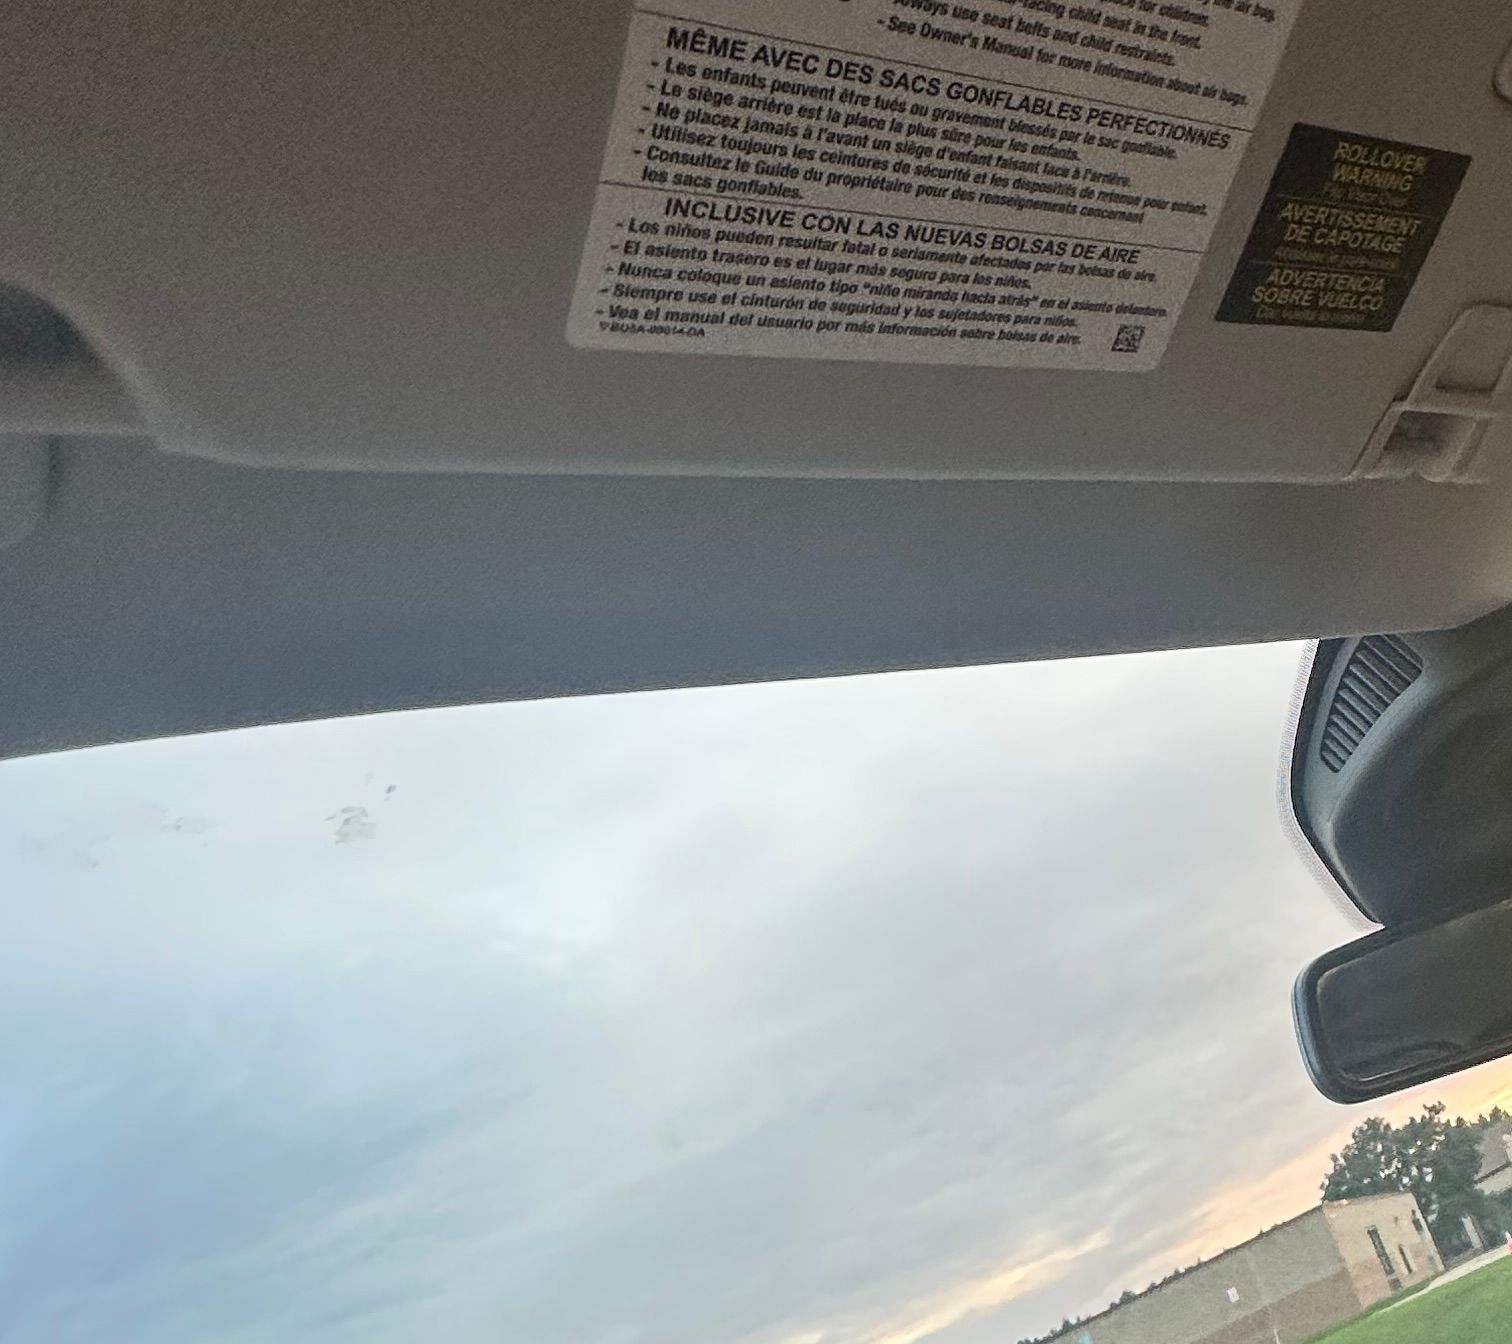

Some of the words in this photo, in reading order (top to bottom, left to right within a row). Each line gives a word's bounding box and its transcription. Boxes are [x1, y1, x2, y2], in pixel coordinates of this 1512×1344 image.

[886, 15, 916, 34] See
[951, 5, 978, 21] use
[664, 56, 696, 76] Les
[701, 67, 766, 88] enfants
[770, 79, 835, 100] peuvent
[666, 27, 746, 61] MÊME
[751, 45, 819, 74] AVEC
[825, 58, 873, 84] DES
[879, 69, 940, 96] SACS
[946, 82, 1081, 121] GONFLABLES
[1086, 108, 1230, 147] PERFECTIONNÉS
[683, 108, 740, 128] placez
[743, 116, 798, 137] jamais
[687, 86, 733, 106] siège
[737, 96, 793, 114] arrière
[797, 105, 823, 119] est
[843, 112, 885, 130] place
[720, 134, 787, 156] toujours
[792, 143, 815, 160] les
[819, 151, 888, 169] ceintures
[1334, 141, 1429, 174] ROLLOVER
[641, 166, 667, 183] les
[672, 173, 711, 188] sacs
[716, 179, 805, 198] gonflables.
[646, 146, 731, 169] Consultez
[754, 160, 799, 178] Guide
[826, 172, 911, 193] propriétaire
[1331, 162, 1414, 192] WARNING
[628, 218, 659, 234] Los
[664, 223, 710, 239] niños
[714, 230, 773, 245] pueden
[778, 236, 838, 250] resultar
[665, 198, 795, 227] INCLUSIVE
[801, 213, 851, 234] CON
[856, 219, 899, 239] LAS
[904, 225, 986, 248] NUEVAS
[991, 234, 1067, 256] BOLSAS
[1070, 242, 1097, 259] DE
[1097, 246, 1141, 264] AIRE
[1279, 202, 1423, 236] AVERTISSEMENT
[1284, 223, 1309, 243] DE
[1314, 226, 1408, 254] CAPOTAGE
[644, 244, 707, 260] asiento
[712, 249, 769, 266] trasero
[813, 258, 853, 274] lugar
[617, 263, 672, 279] Nunca
[677, 269, 741, 285] coloque
[769, 276, 825, 290] asiento
[1266, 268, 1386, 293] ADVERTENCIA
[613, 284, 683, 302] Siempre
[687, 292, 717, 303] use
[740, 294, 804, 309] cinturón
[1252, 286, 1313, 306] SOBRE
[1318, 291, 1385, 311] VUELCO
[608, 305, 639, 320] Vea
[664, 310, 724, 324] manual
[728, 312, 754, 326] del
